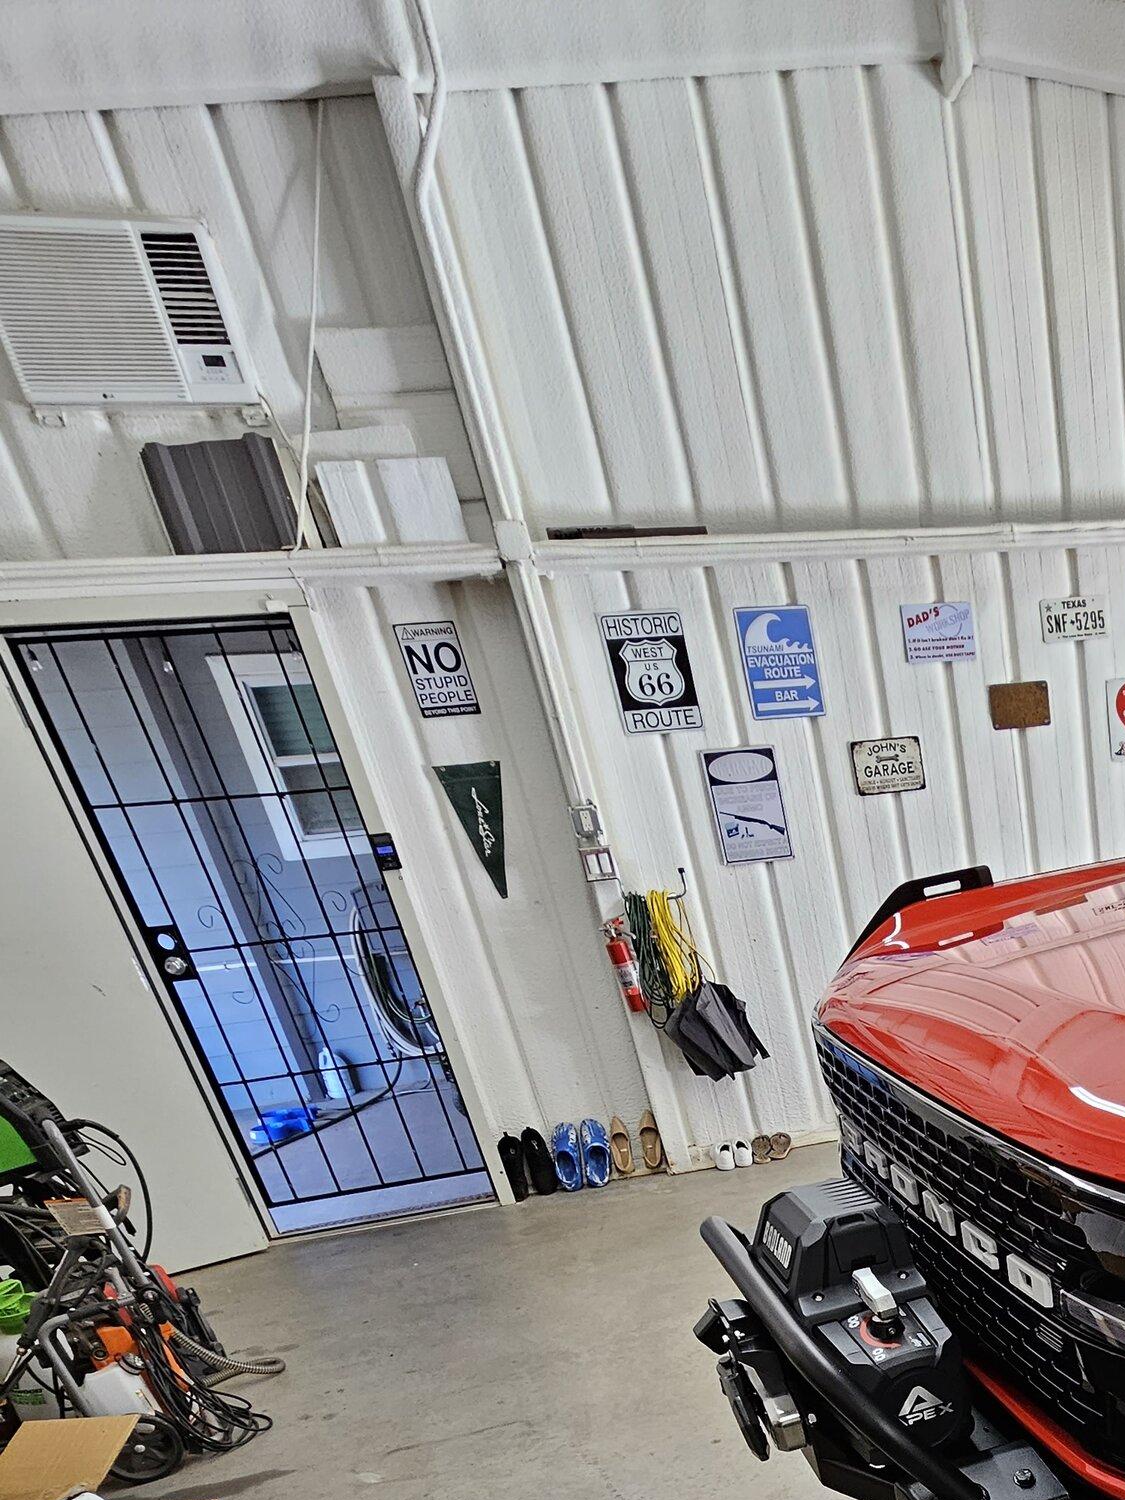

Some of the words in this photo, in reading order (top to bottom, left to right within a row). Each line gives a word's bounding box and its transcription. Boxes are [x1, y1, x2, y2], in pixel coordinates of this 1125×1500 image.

[1061, 599, 1087, 609] TEXAS
[907, 606, 940, 628] DAD'S
[410, 627, 453, 637] WARNING
[605, 616, 679, 636] HISTORIC
[631, 647, 663, 658] WEST
[747, 644, 784, 654] TSUNAMI
[404, 642, 462, 675] NO
[747, 653, 815, 668] EVACUATION
[764, 666, 801, 679] ROUTE
[415, 675, 468, 690] STUPID
[639, 673, 674, 696] 66
[419, 690, 474, 705] PEOPLE
[775, 690, 799, 701] BAR
[424, 708, 447, 716] BEYOND
[632, 709, 696, 730] ROUTE
[867, 742, 907, 756] JOHN'S
[864, 761, 915, 778] GARAGE
[840, 1115, 1053, 1308] BRONCO
[763, 1220, 792, 1269] BADLAND
